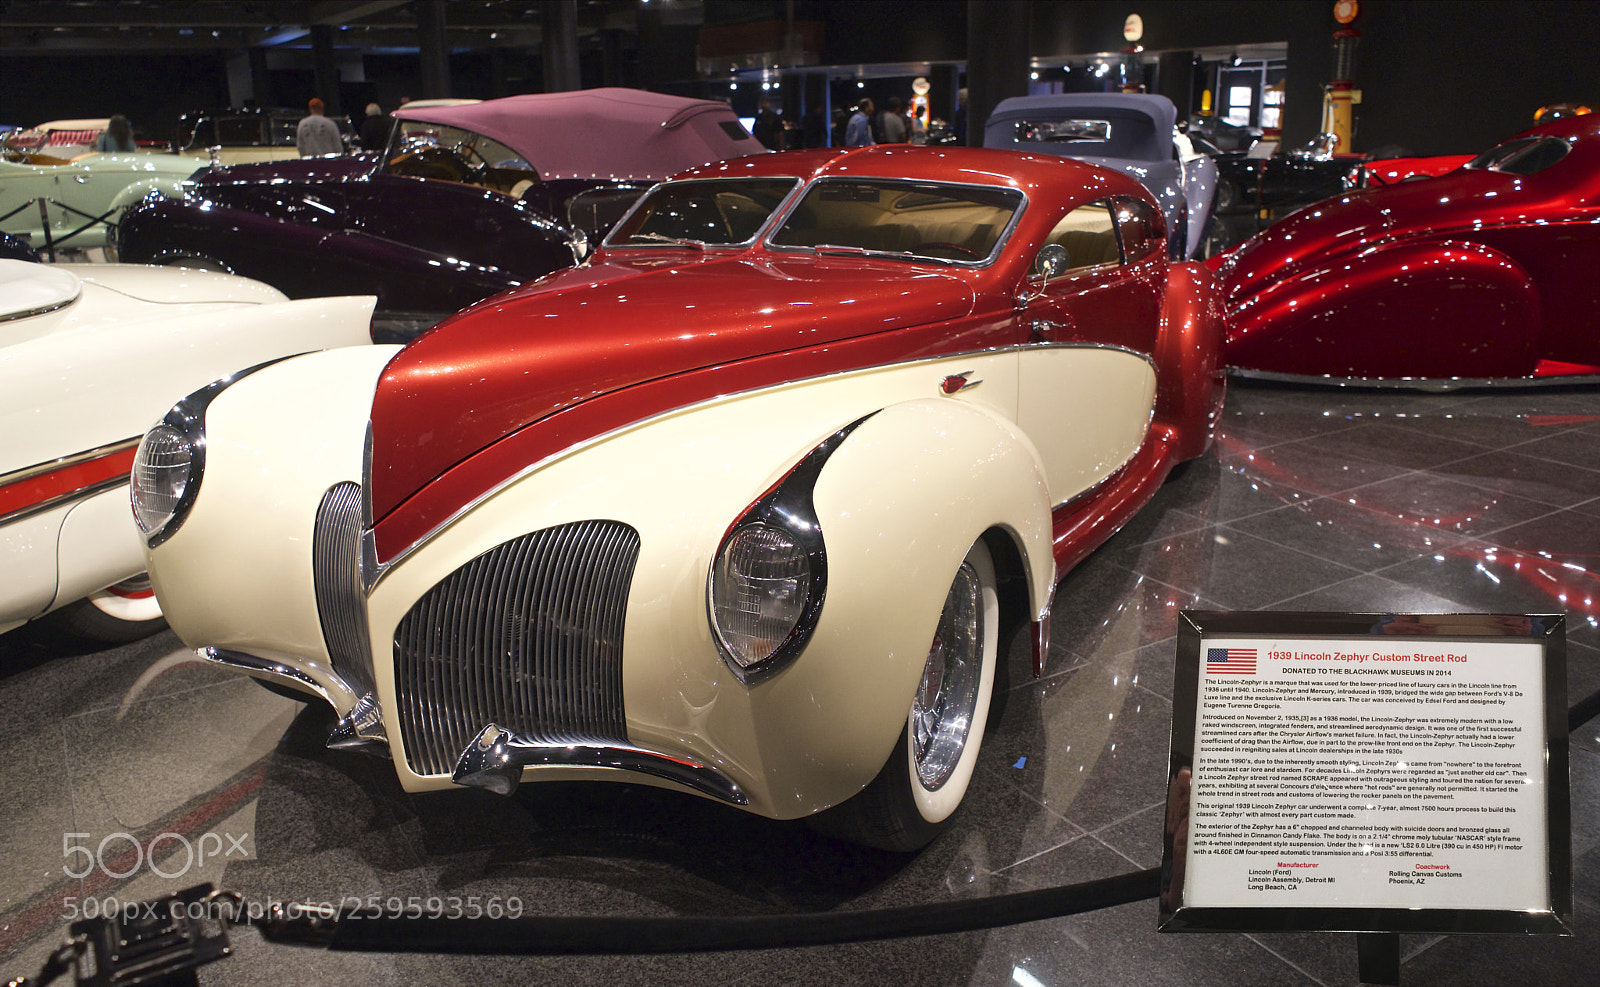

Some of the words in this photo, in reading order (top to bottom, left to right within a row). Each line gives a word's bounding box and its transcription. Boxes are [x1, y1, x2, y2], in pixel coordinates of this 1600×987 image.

[1268, 651, 1292, 659] 1939
[1294, 651, 1331, 660] Lincoln
[1333, 652, 1369, 662] Zephyr
[1372, 652, 1410, 661] Custom
[1413, 653, 1444, 662] Street
[1446, 653, 1467, 662] Rod
[1388, 870, 1410, 879] Rolling
